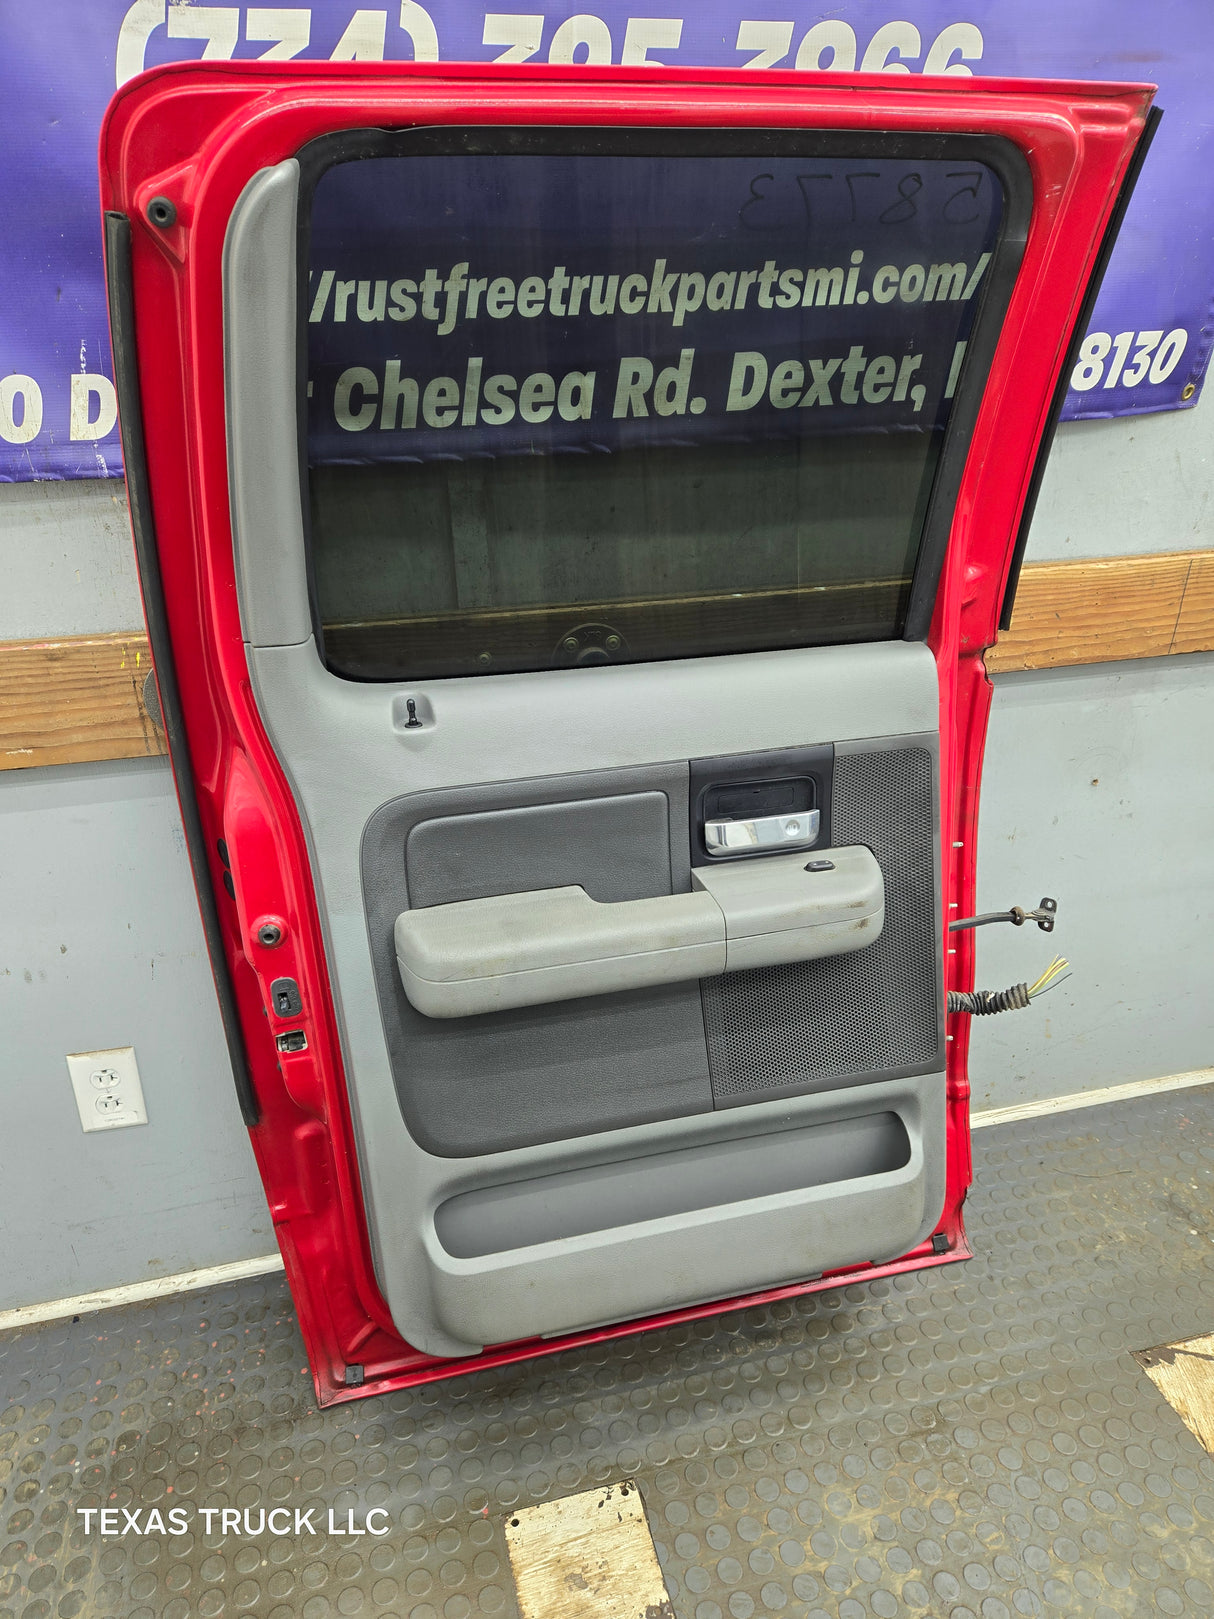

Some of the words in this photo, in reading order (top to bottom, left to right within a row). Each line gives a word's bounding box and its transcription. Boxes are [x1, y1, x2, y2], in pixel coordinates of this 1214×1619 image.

[308, 249, 993, 336] /rustfreetruckpartsmi.com/
[333, 357, 597, 432] Chelsea
[612, 348, 707, 419] Rd.
[725, 346, 927, 412] Dexter,
[1070, 328, 1188, 391] 8130
